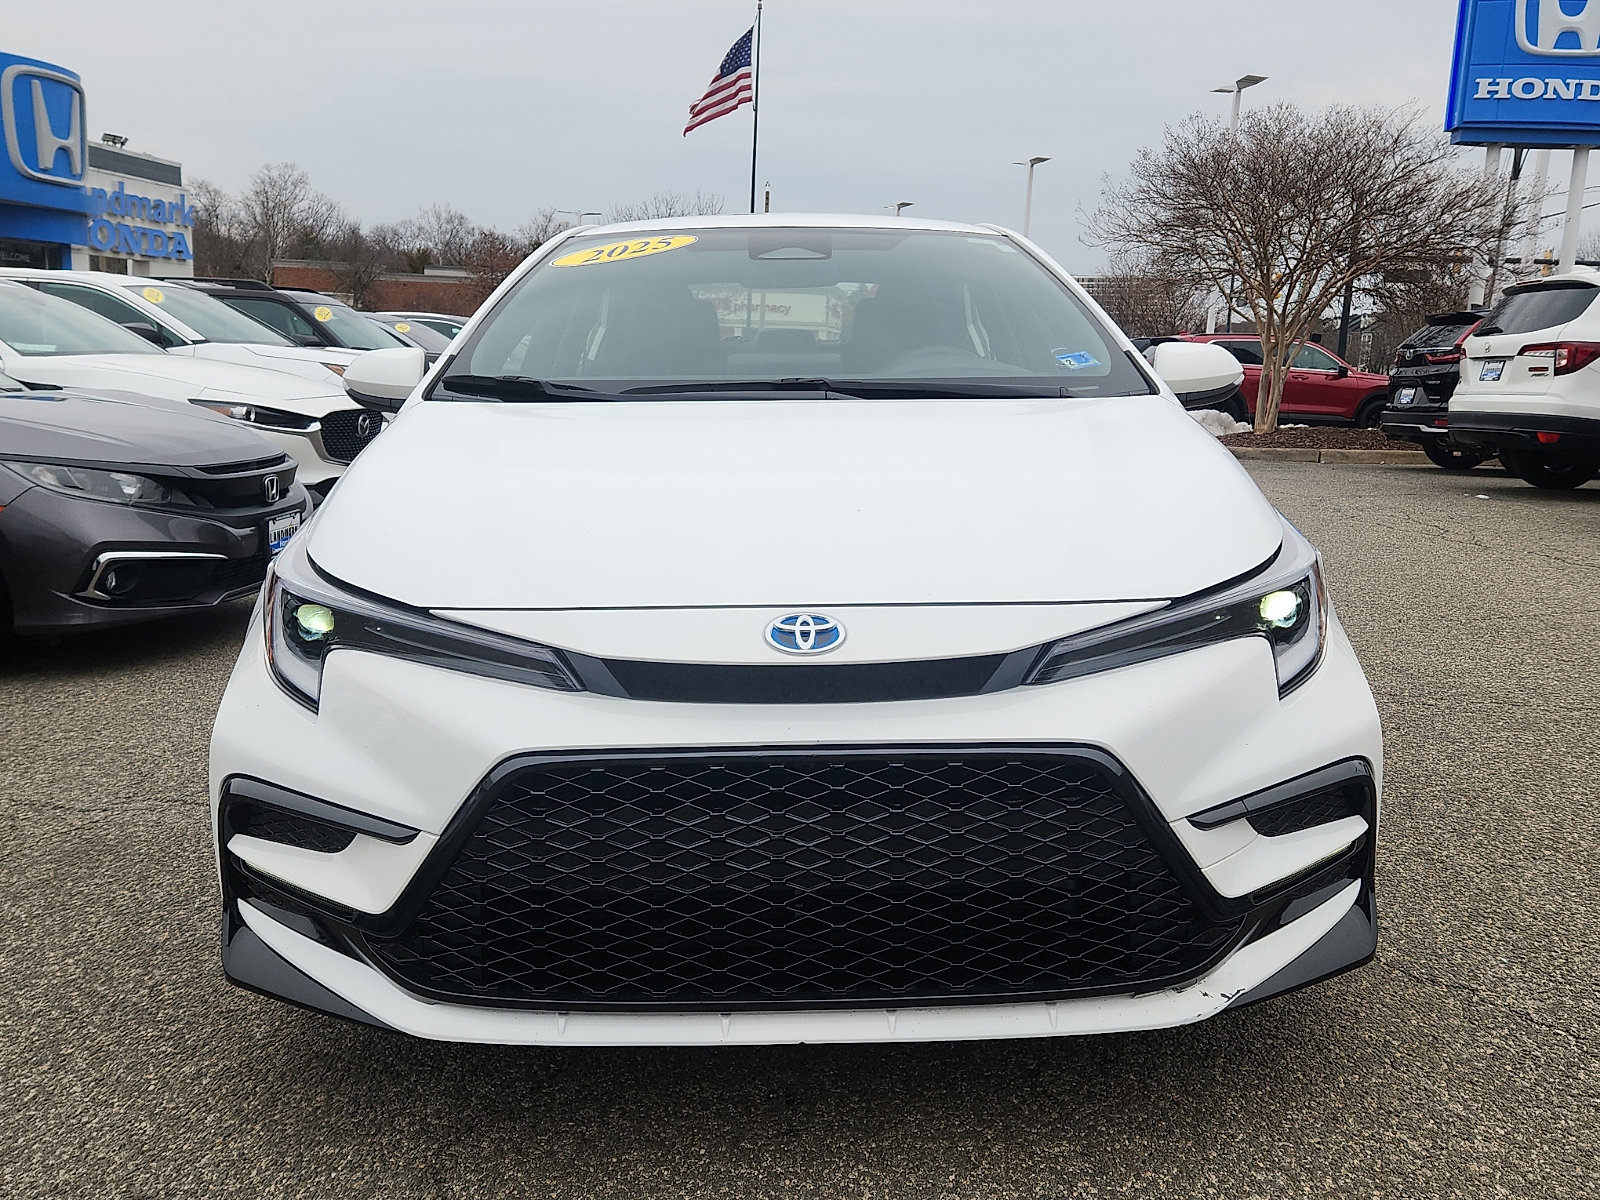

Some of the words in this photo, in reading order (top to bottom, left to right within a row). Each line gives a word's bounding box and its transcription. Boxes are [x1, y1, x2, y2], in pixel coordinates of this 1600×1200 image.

[1473, 77, 1600, 100] HOND
[81, 181, 194, 229] ndmark
[581, 236, 674, 263] 2025
